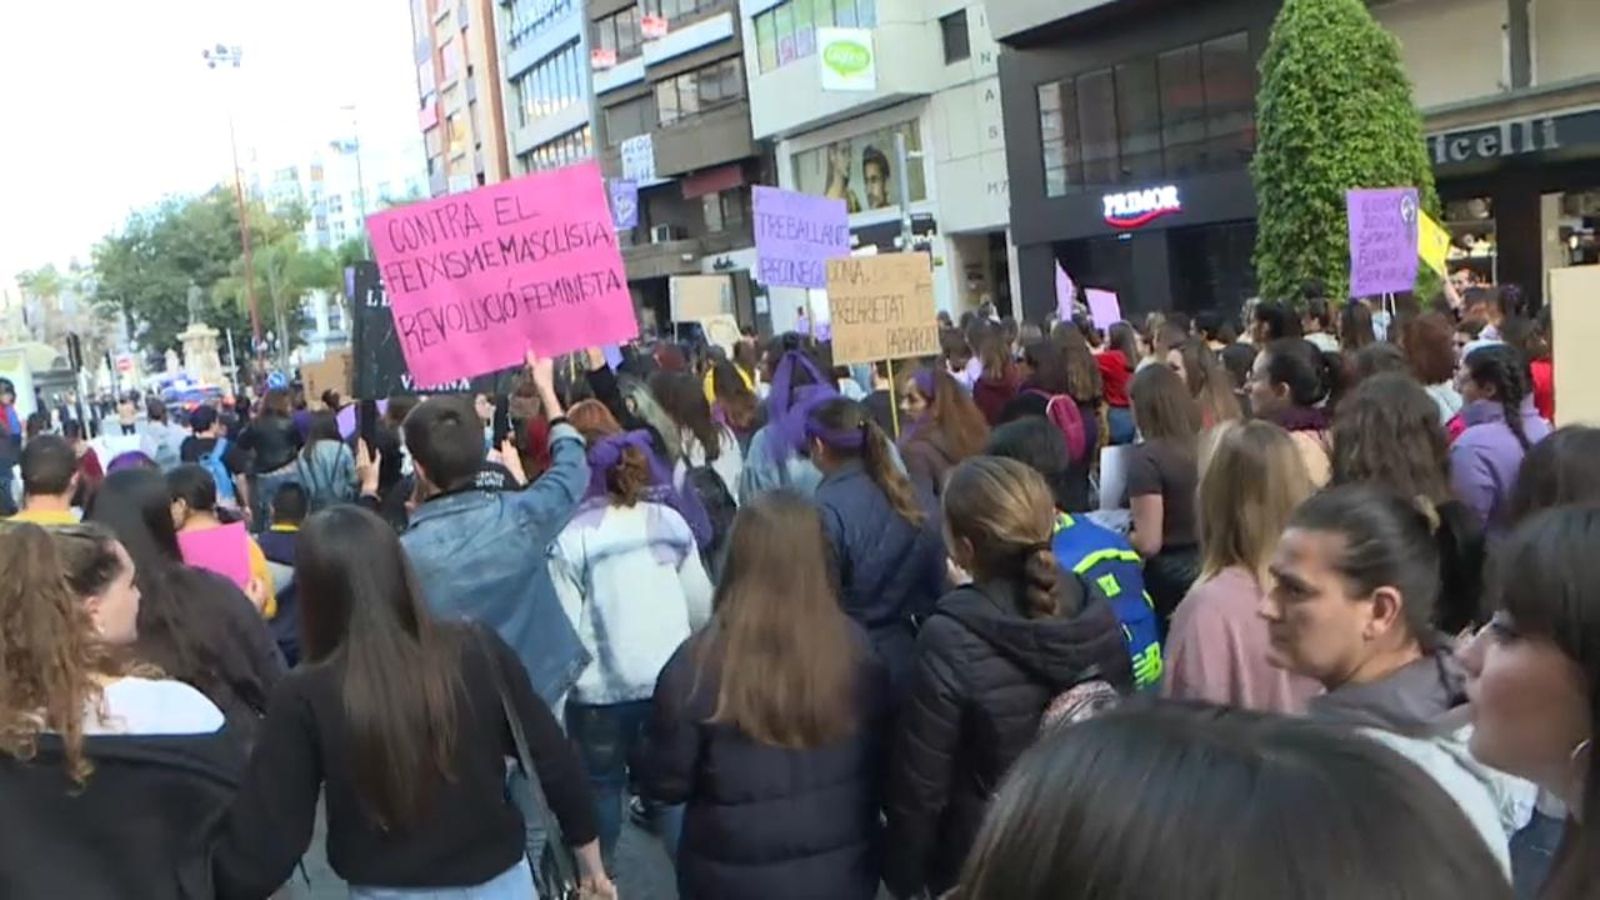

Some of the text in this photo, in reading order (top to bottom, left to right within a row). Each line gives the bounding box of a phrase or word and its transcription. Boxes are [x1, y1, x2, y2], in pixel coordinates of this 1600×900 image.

[388, 195, 541, 254] CONTRA EL
[1102, 185, 1181, 217] PRIMOR
[384, 241, 500, 294] FEIXISME
[399, 269, 622, 355] REVOLUCIÓ FEMINISTA
